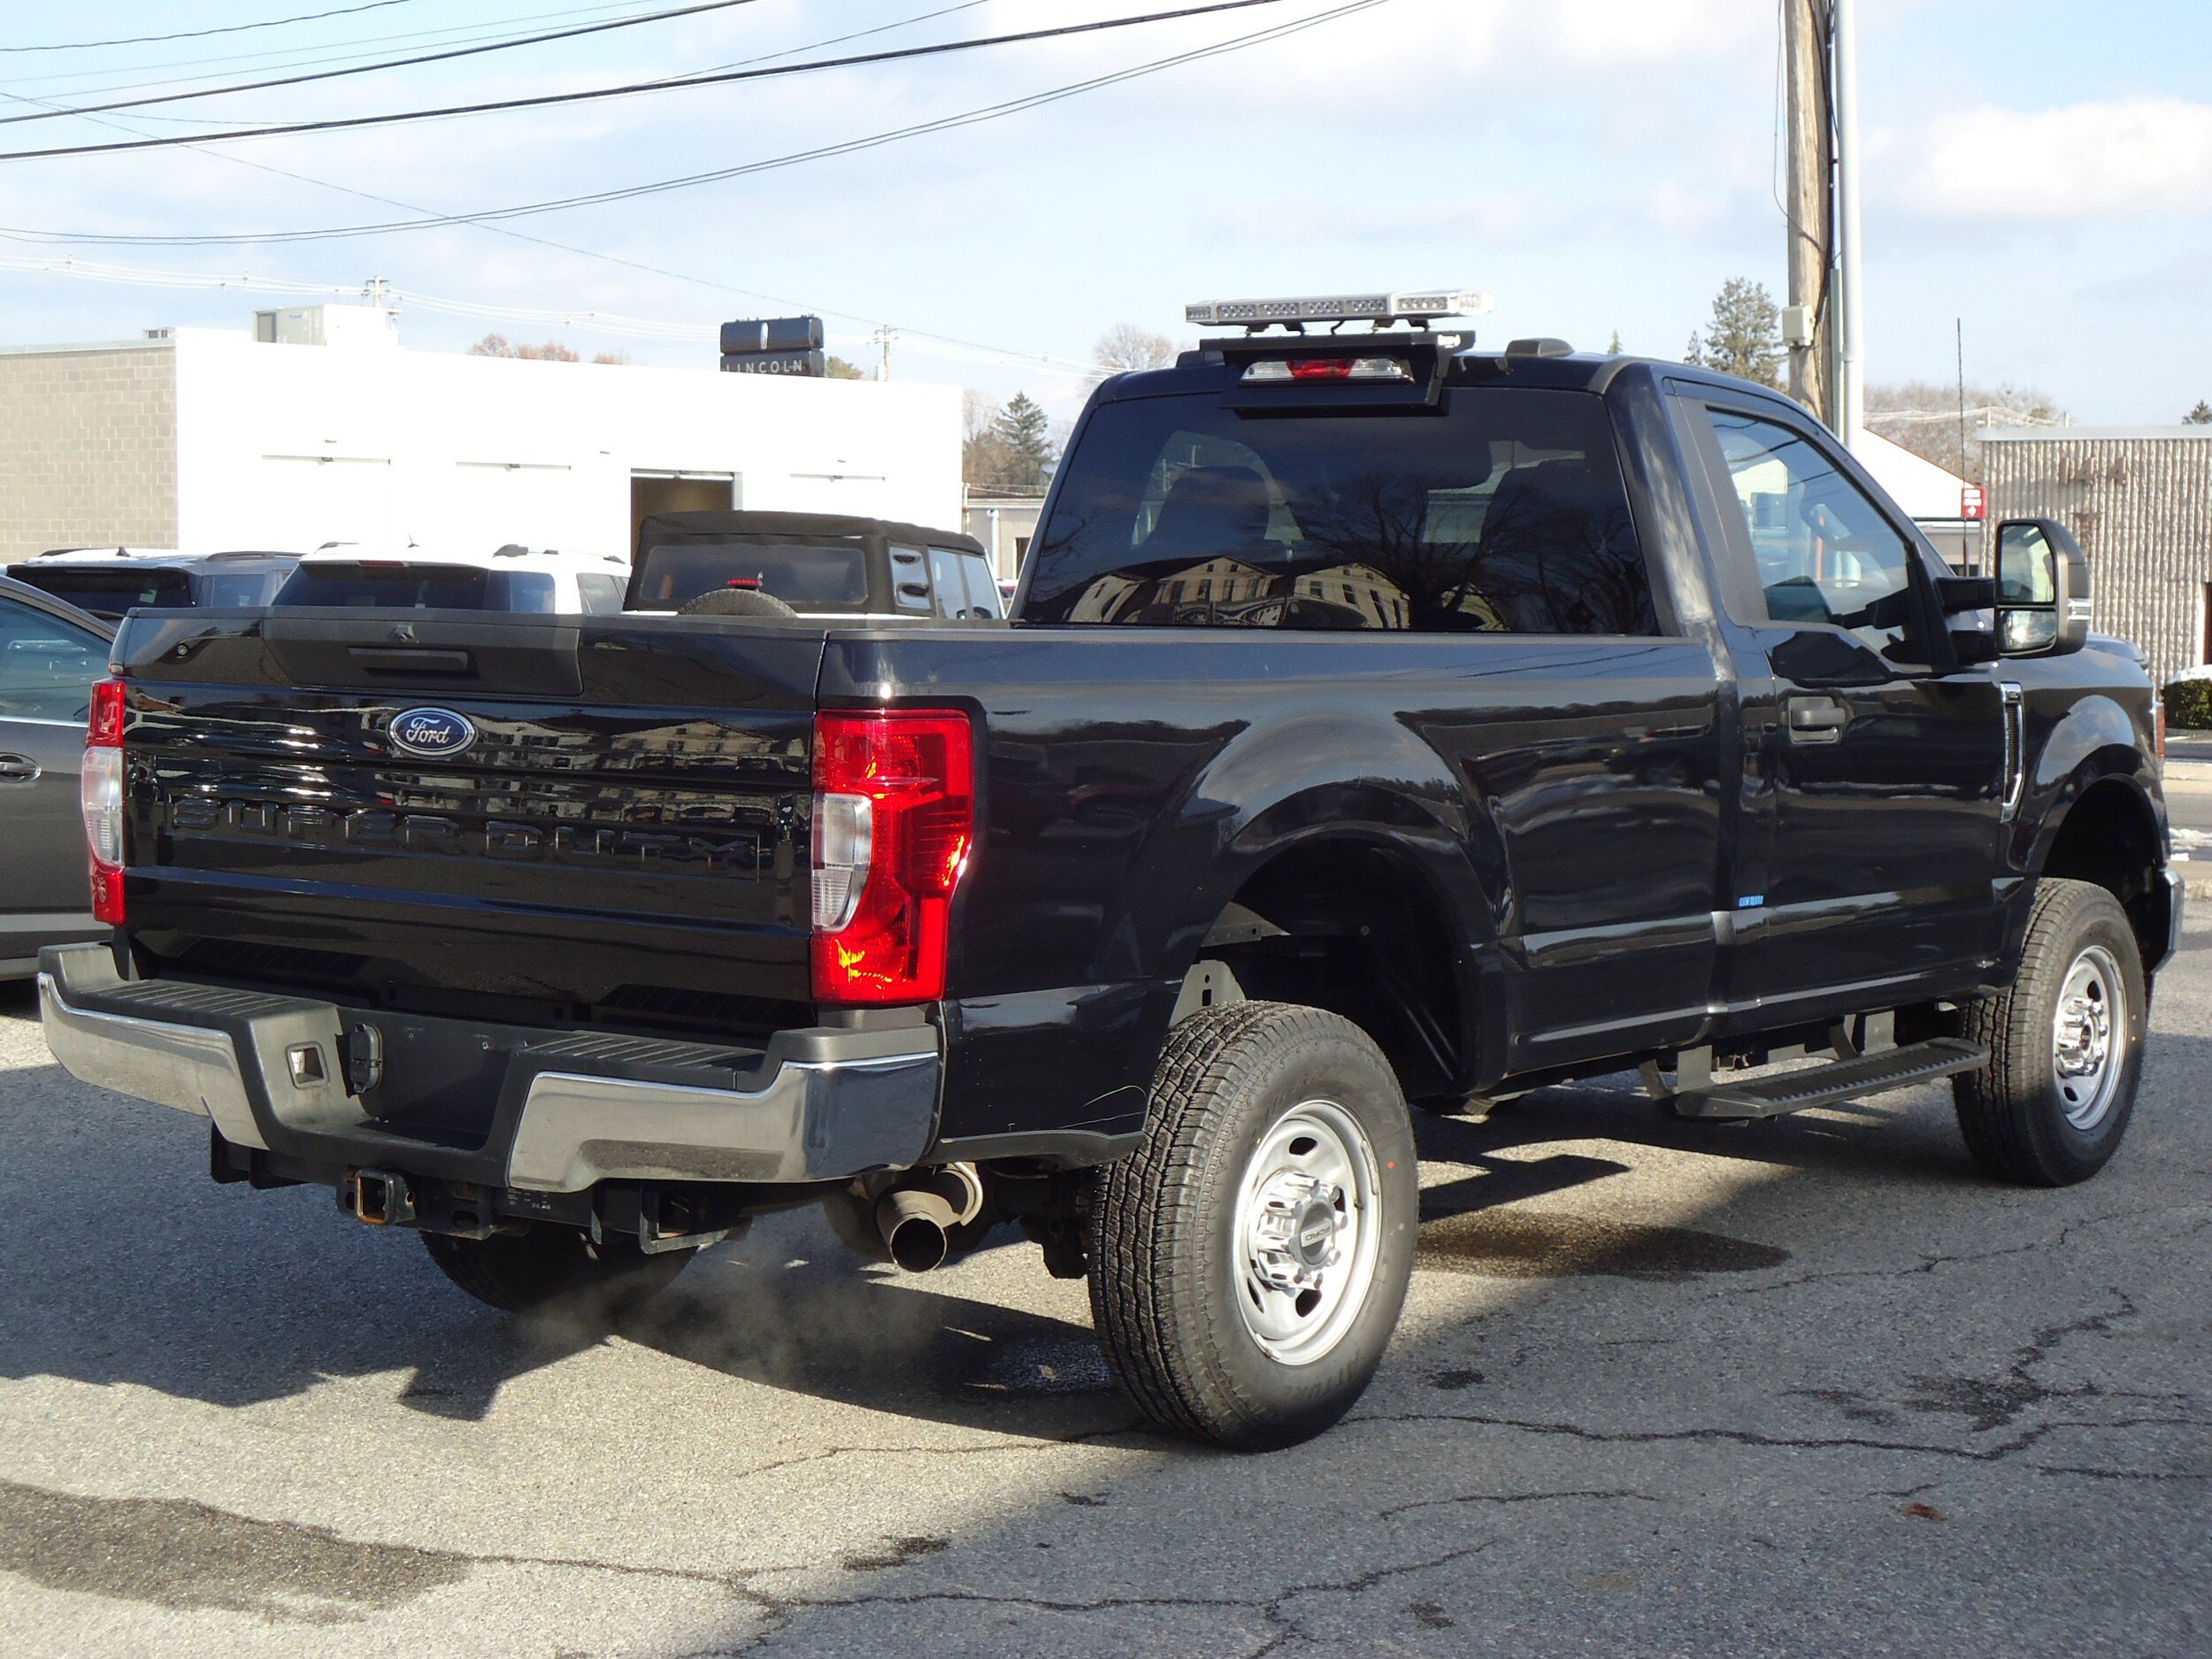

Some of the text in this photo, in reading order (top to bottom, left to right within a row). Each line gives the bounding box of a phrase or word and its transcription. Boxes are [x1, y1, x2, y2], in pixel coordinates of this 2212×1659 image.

[405, 717, 451, 744] Ford
[173, 798, 754, 868] SUPER DUTY
